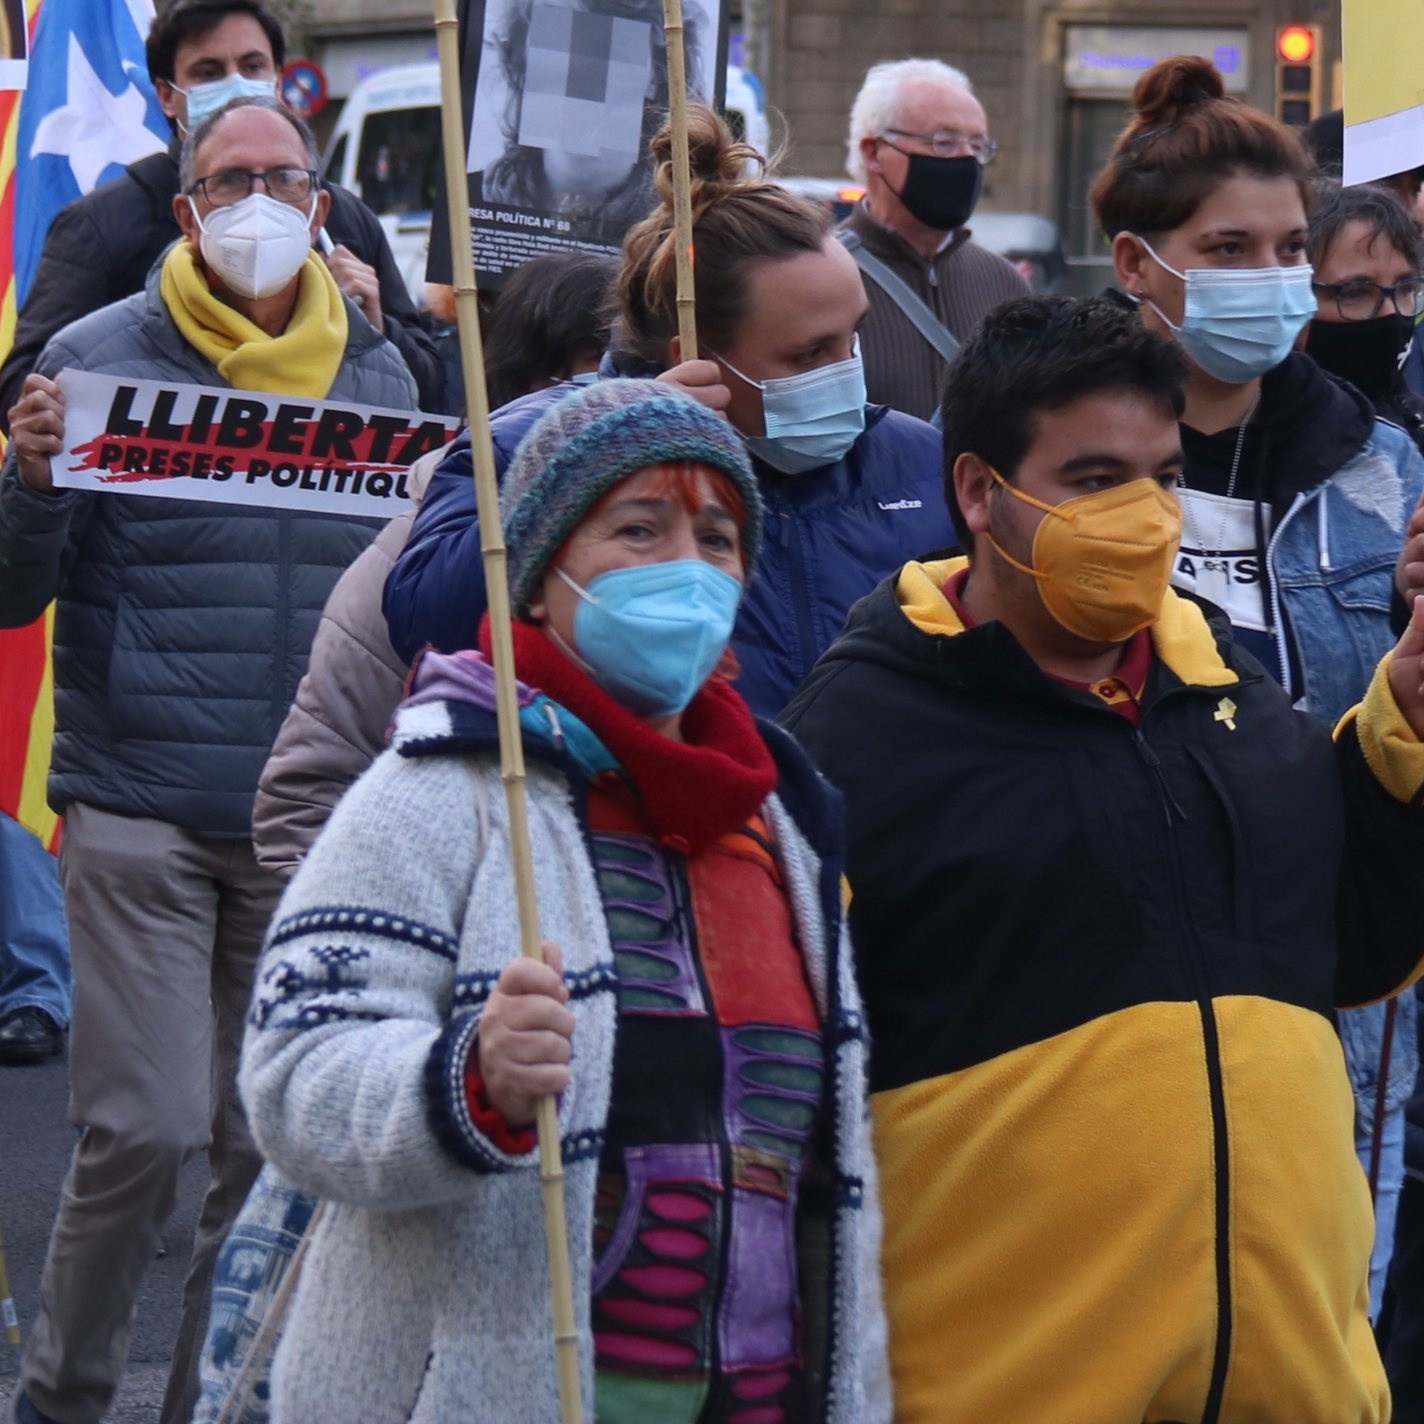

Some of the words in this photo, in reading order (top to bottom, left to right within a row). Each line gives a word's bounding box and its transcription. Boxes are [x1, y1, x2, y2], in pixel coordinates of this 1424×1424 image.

[469, 207, 494, 220] RESA
[496, 211, 541, 228] POLÍTICA
[557, 221, 570, 232] 68
[105, 385, 465, 468] LLIBERTA
[98, 443, 236, 480] PRESES
[244, 459, 408, 500] POLÍTIQU
